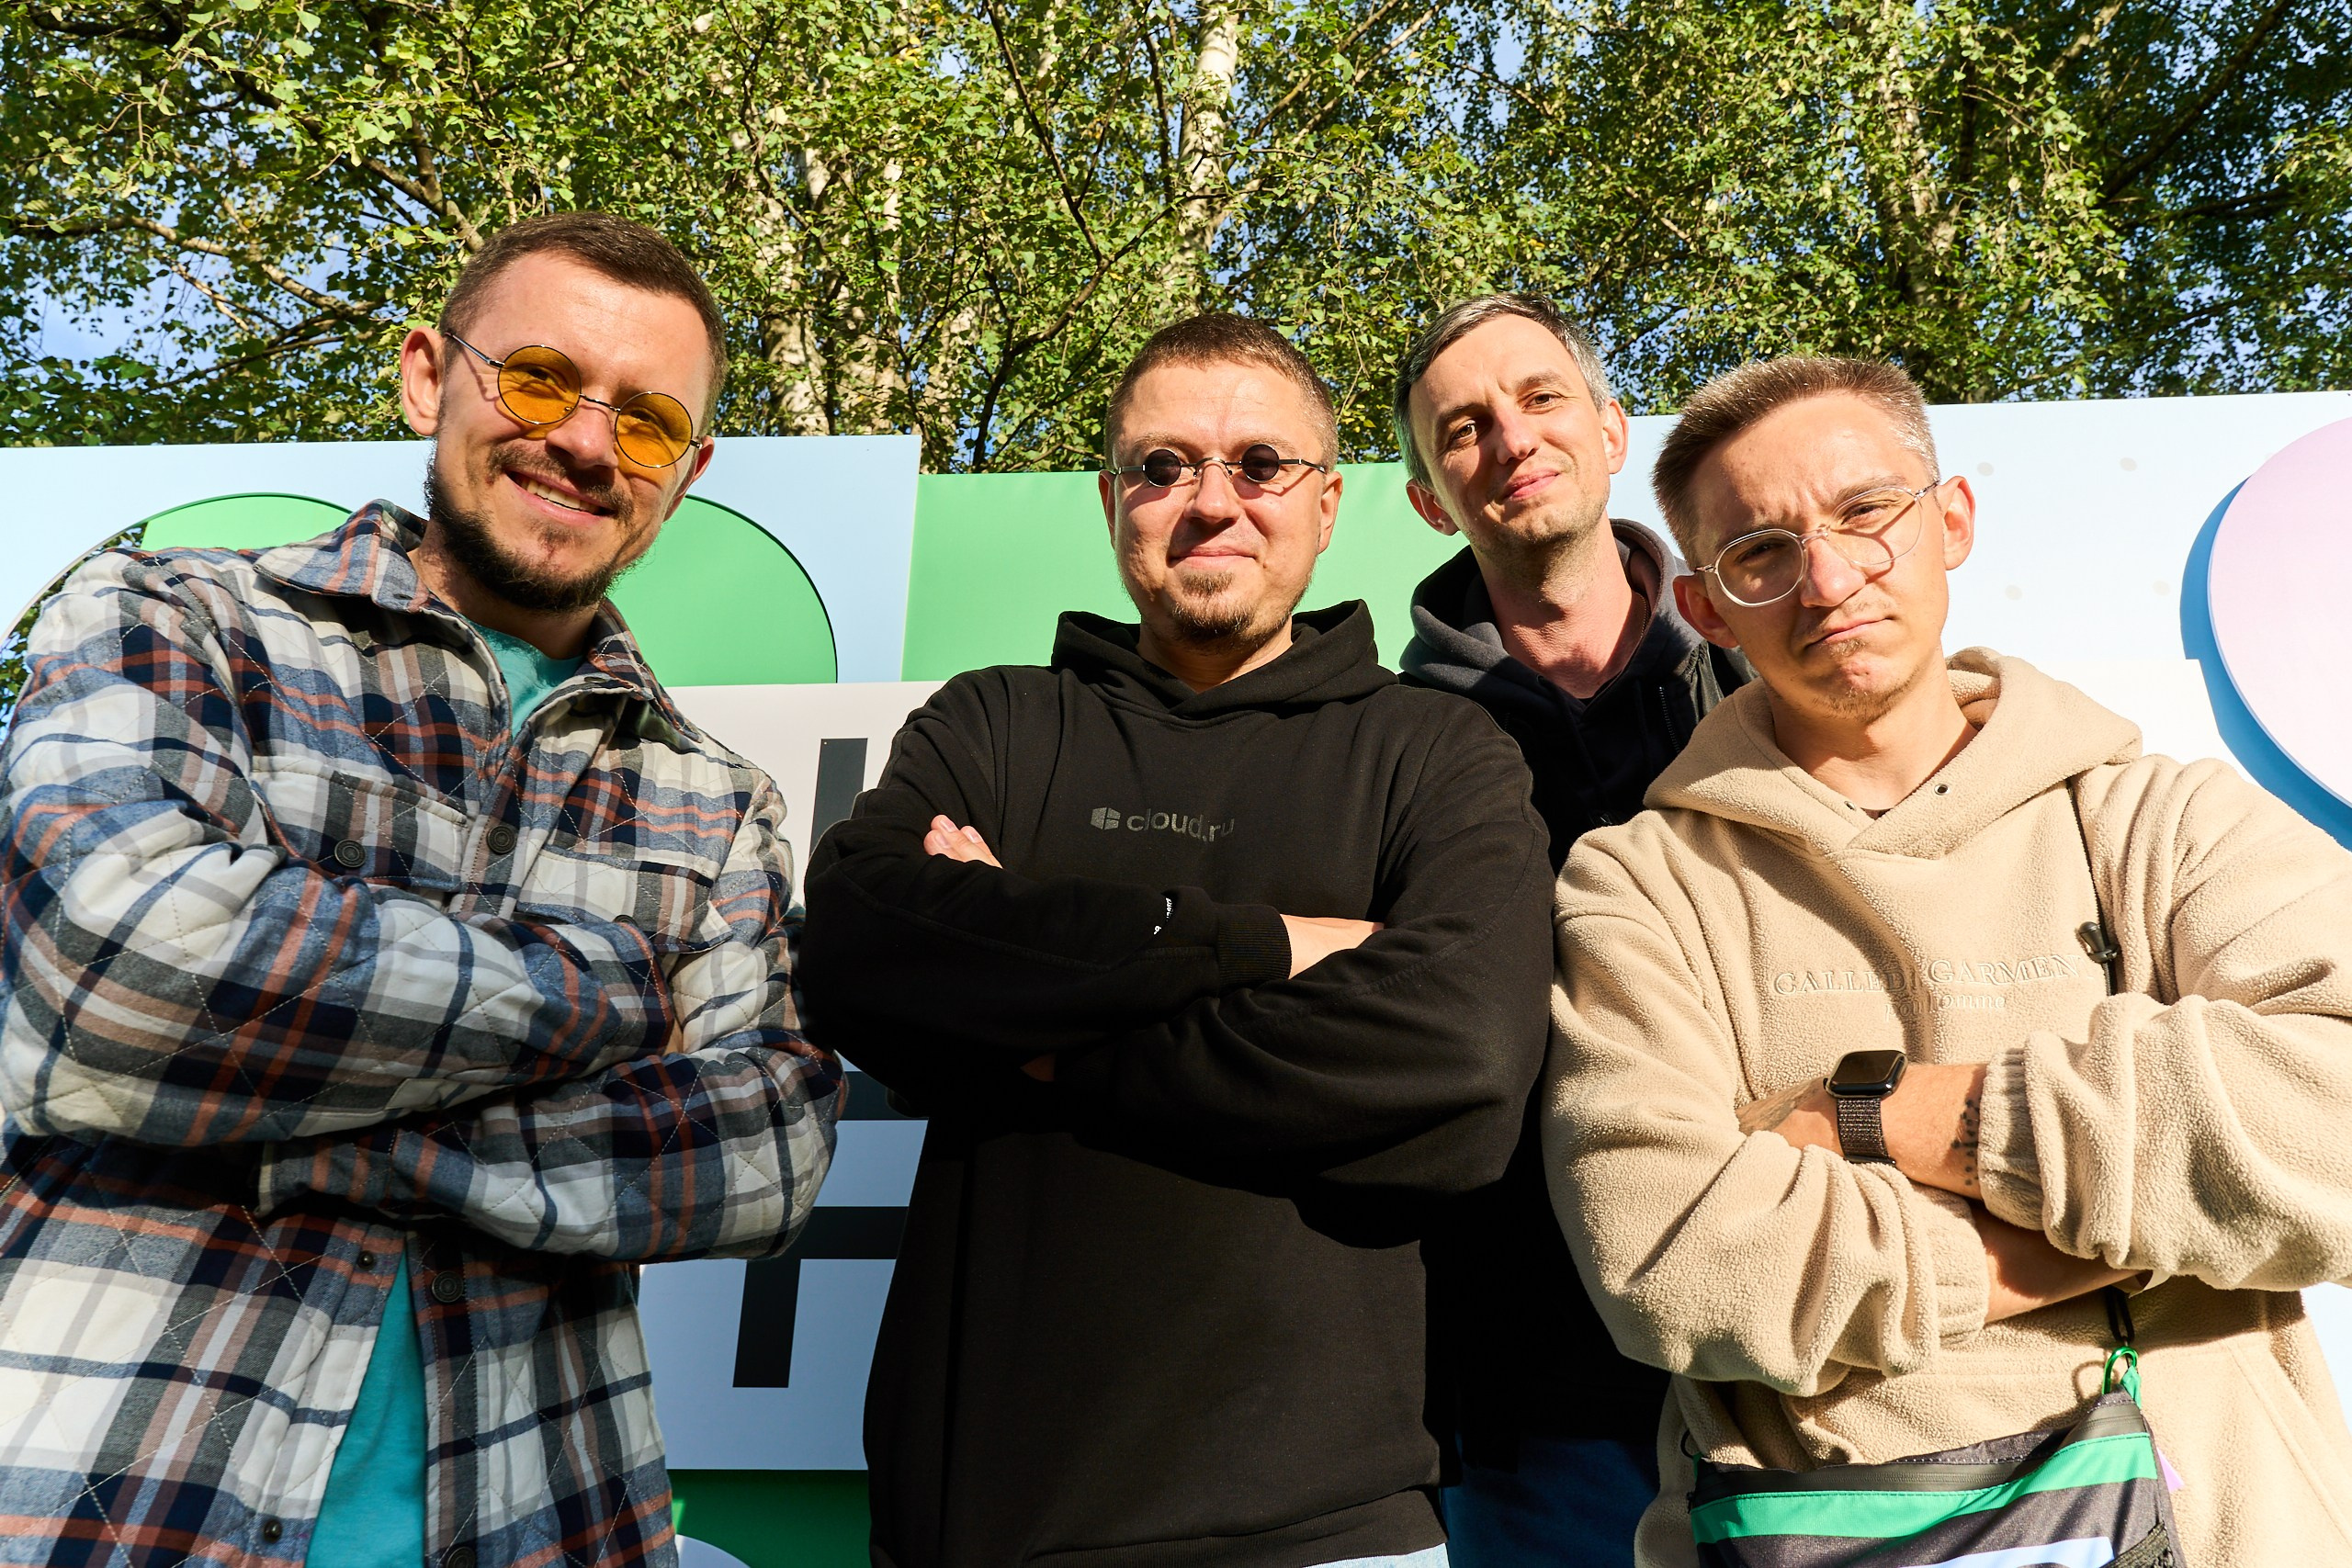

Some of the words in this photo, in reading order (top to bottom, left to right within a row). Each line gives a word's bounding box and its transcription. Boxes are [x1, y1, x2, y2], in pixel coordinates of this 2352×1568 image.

[1126, 807, 1235, 842] cloud.ru
[1774, 968, 1906, 994] CALLED
[1928, 953, 2095, 986] GARMEN
